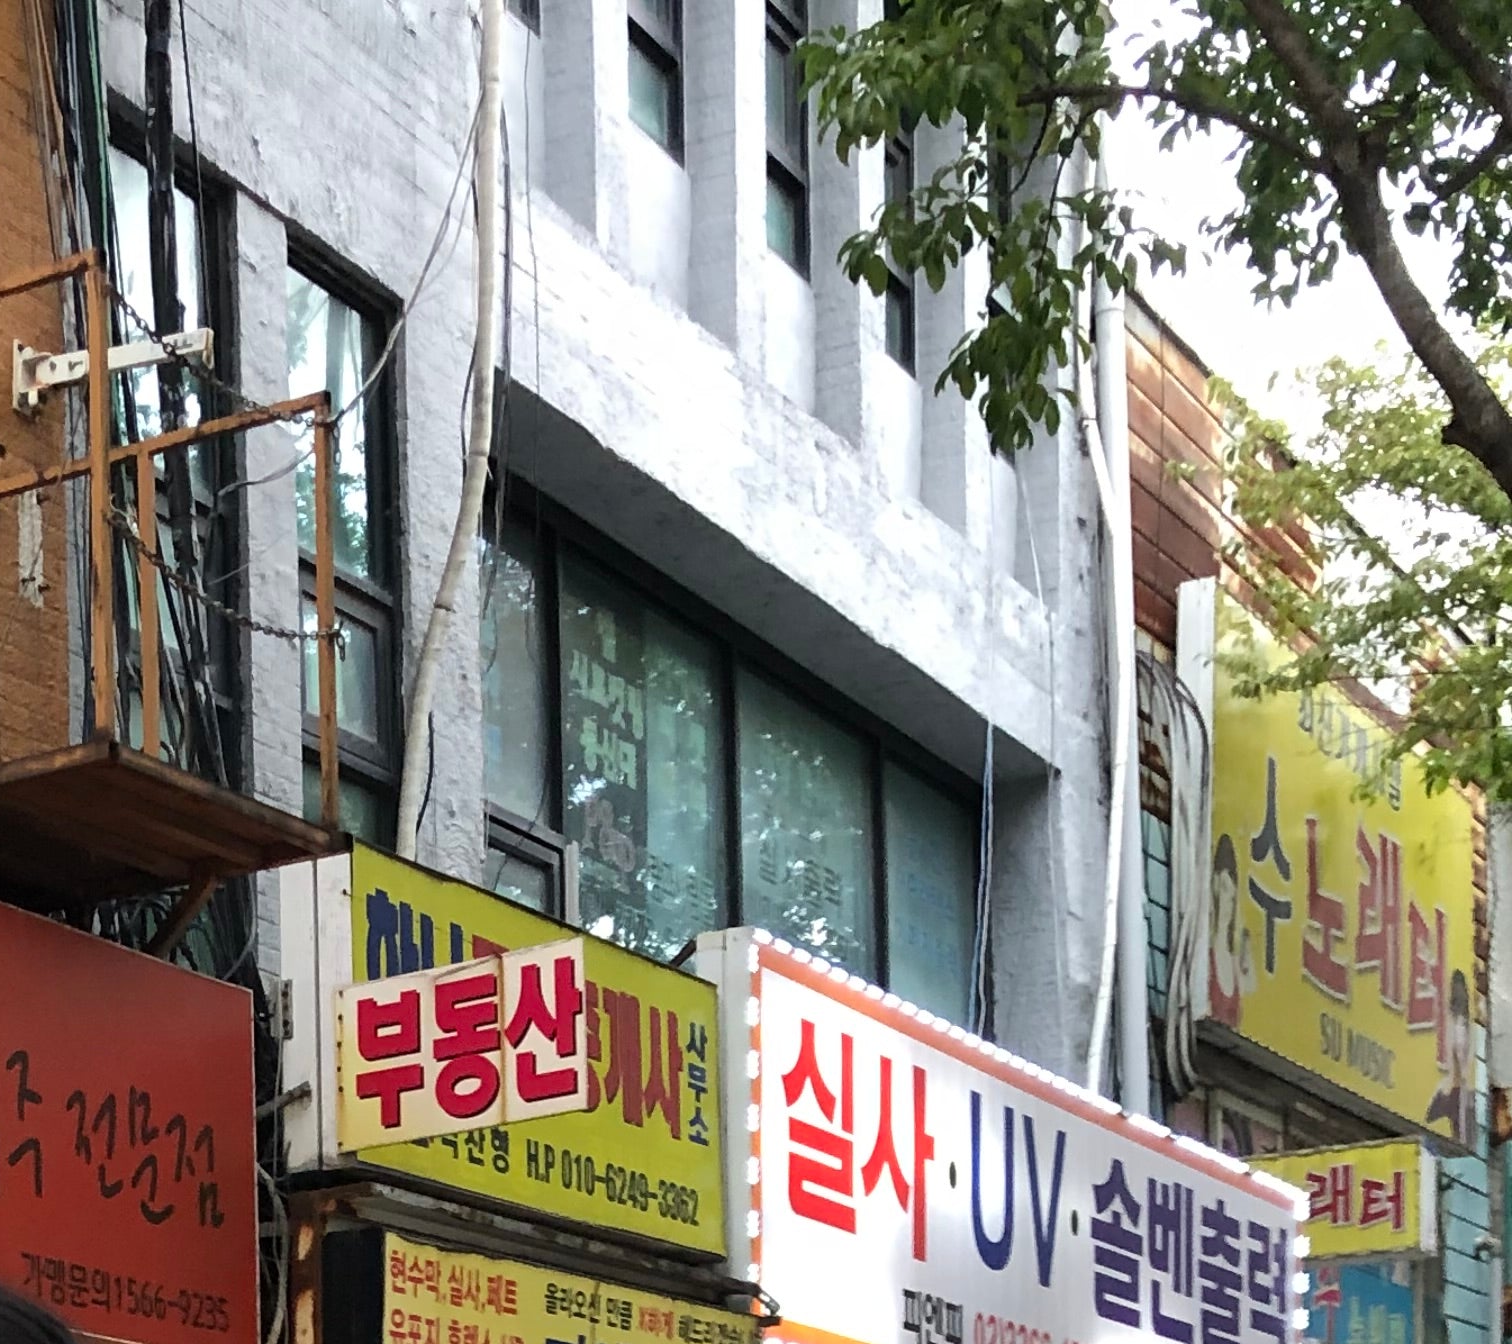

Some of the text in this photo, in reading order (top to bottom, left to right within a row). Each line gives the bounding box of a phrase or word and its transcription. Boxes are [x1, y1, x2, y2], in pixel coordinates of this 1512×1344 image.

[356, 956, 583, 1128] 부동산
[686, 1021, 709, 1146] 사무소
[1319, 1011, 1344, 1059] SU
[66, 1085, 225, 1228] 전문점
[781, 1019, 936, 1262] 실사
[970, 1089, 1067, 1289] UV
